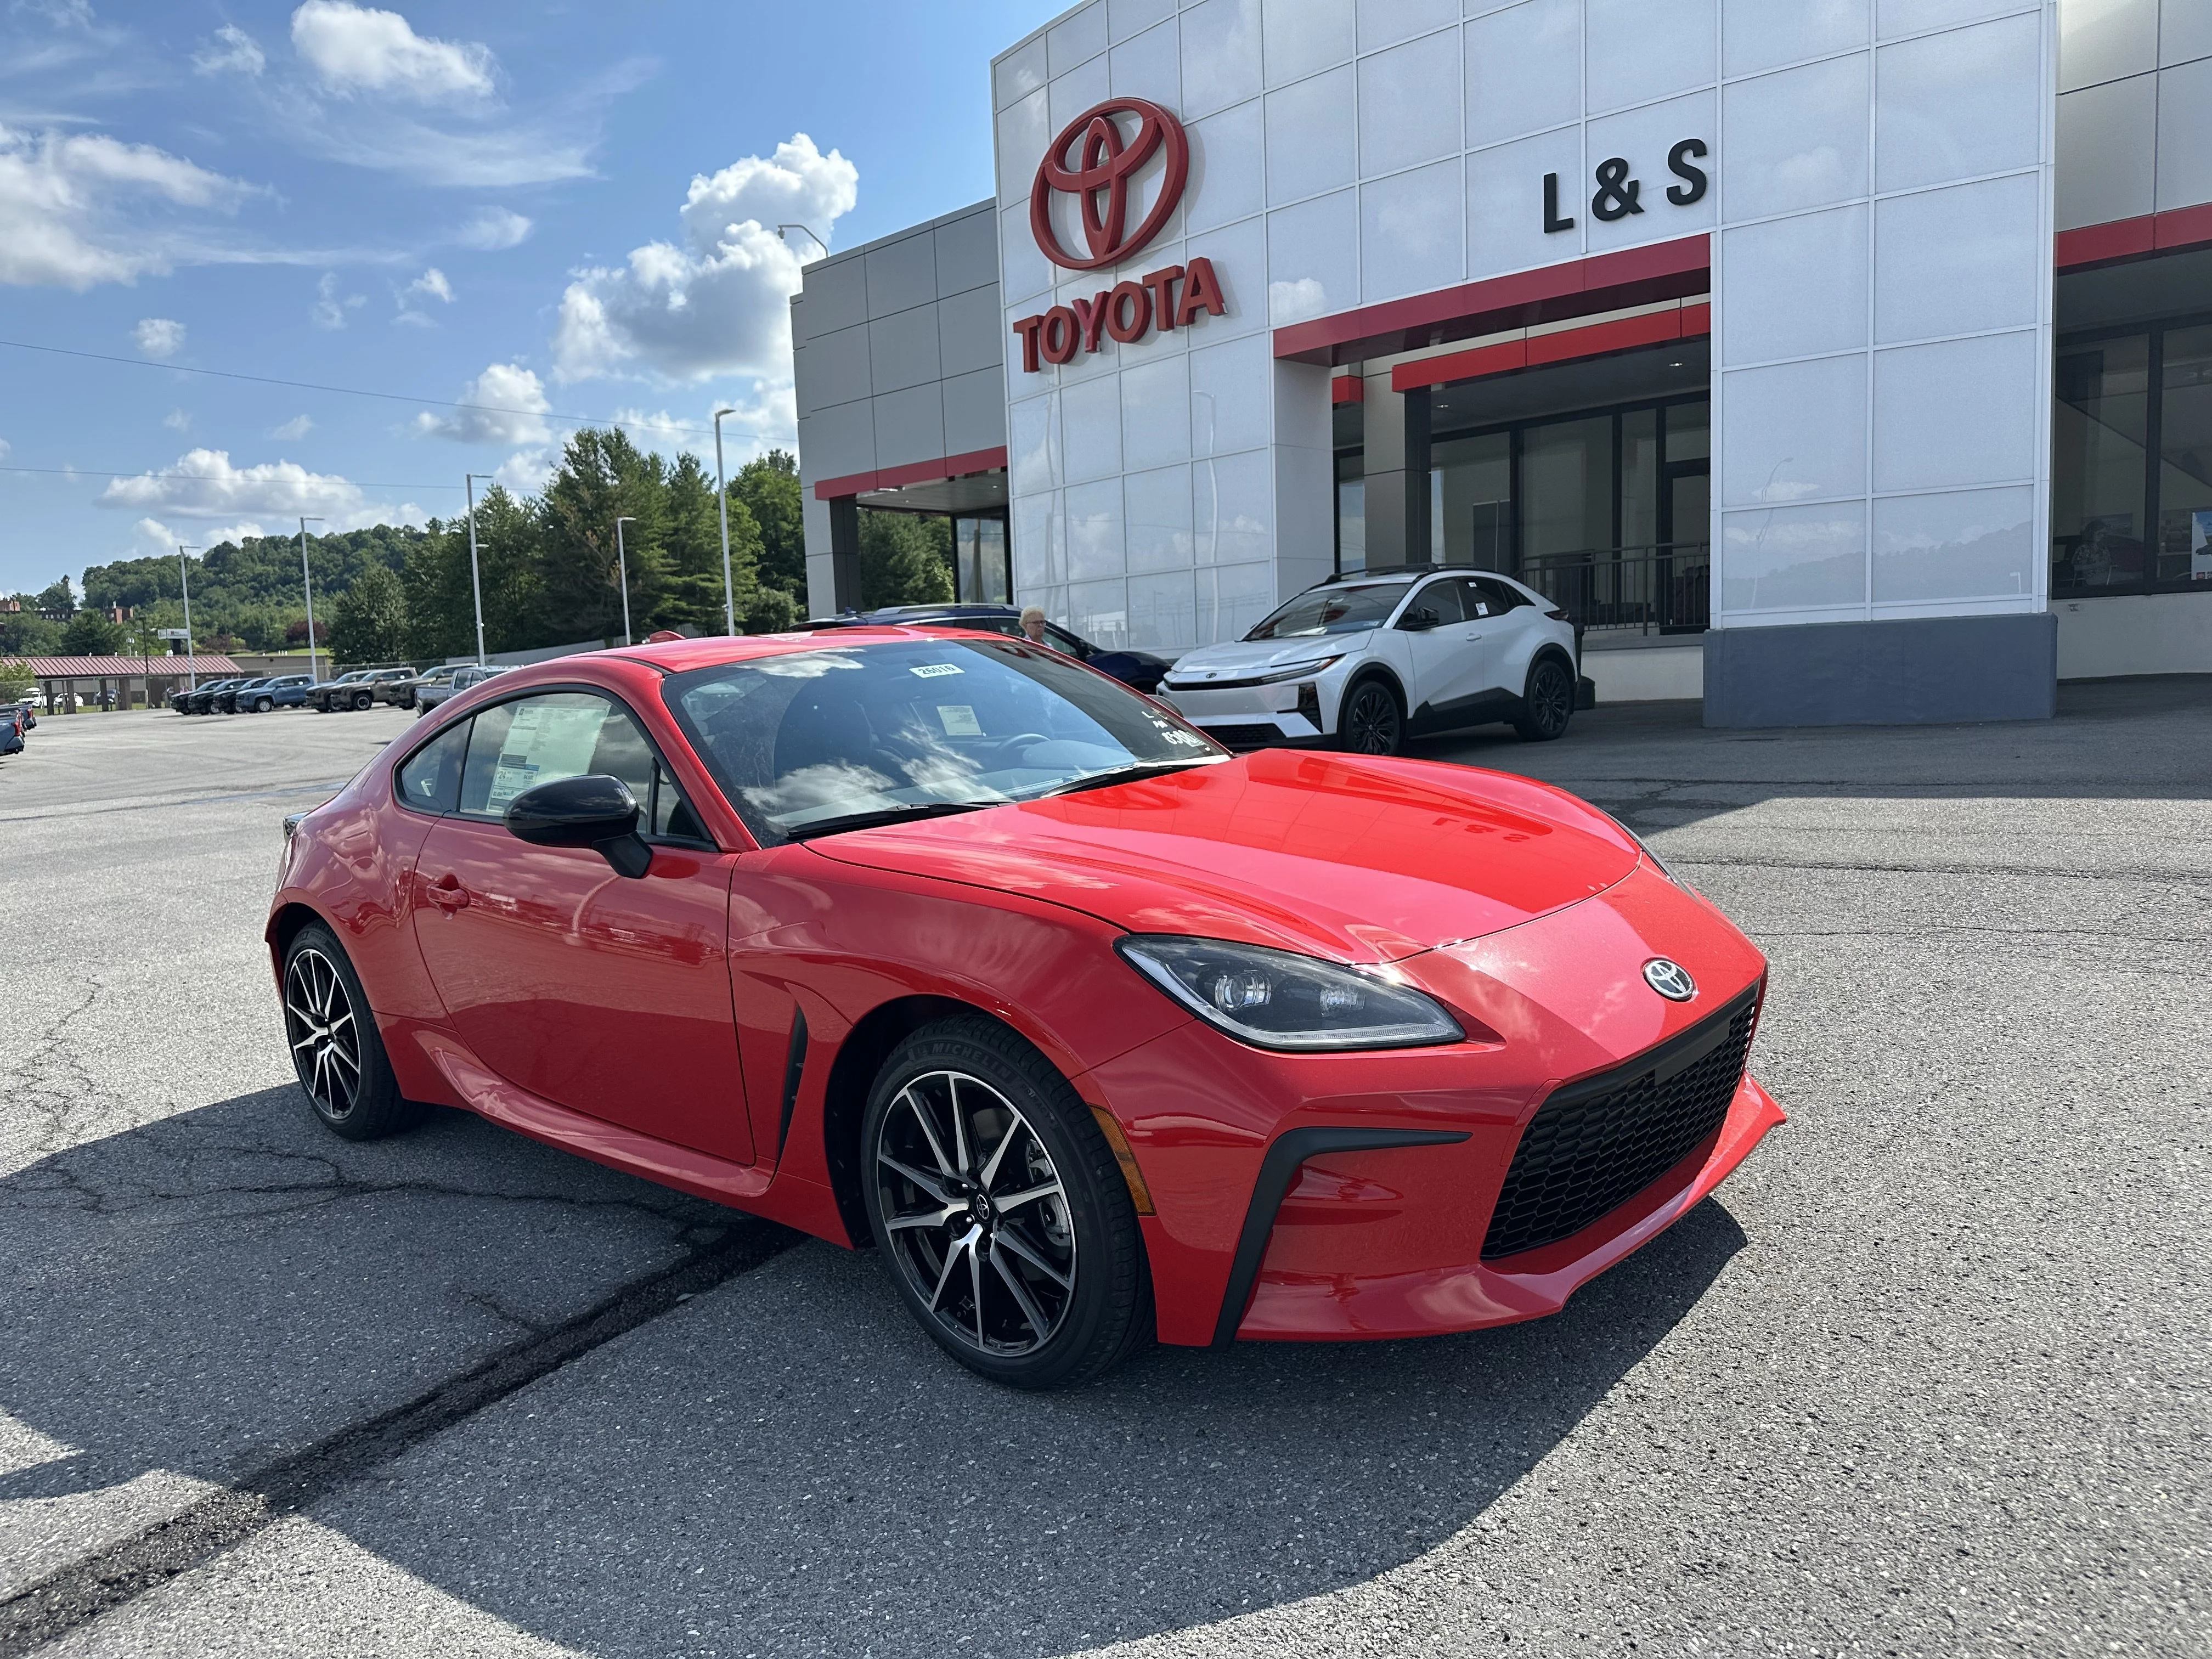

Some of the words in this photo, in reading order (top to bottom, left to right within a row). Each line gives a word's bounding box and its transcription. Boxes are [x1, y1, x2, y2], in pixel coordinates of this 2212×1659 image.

[1543, 172, 1574, 234] L
[1592, 157, 1644, 221] &
[1666, 138, 1707, 206] S
[1013, 257, 1228, 373] TOYOTA
[918, 665, 956, 675] 26016
[932, 1043, 1012, 1079] MICHELIN
